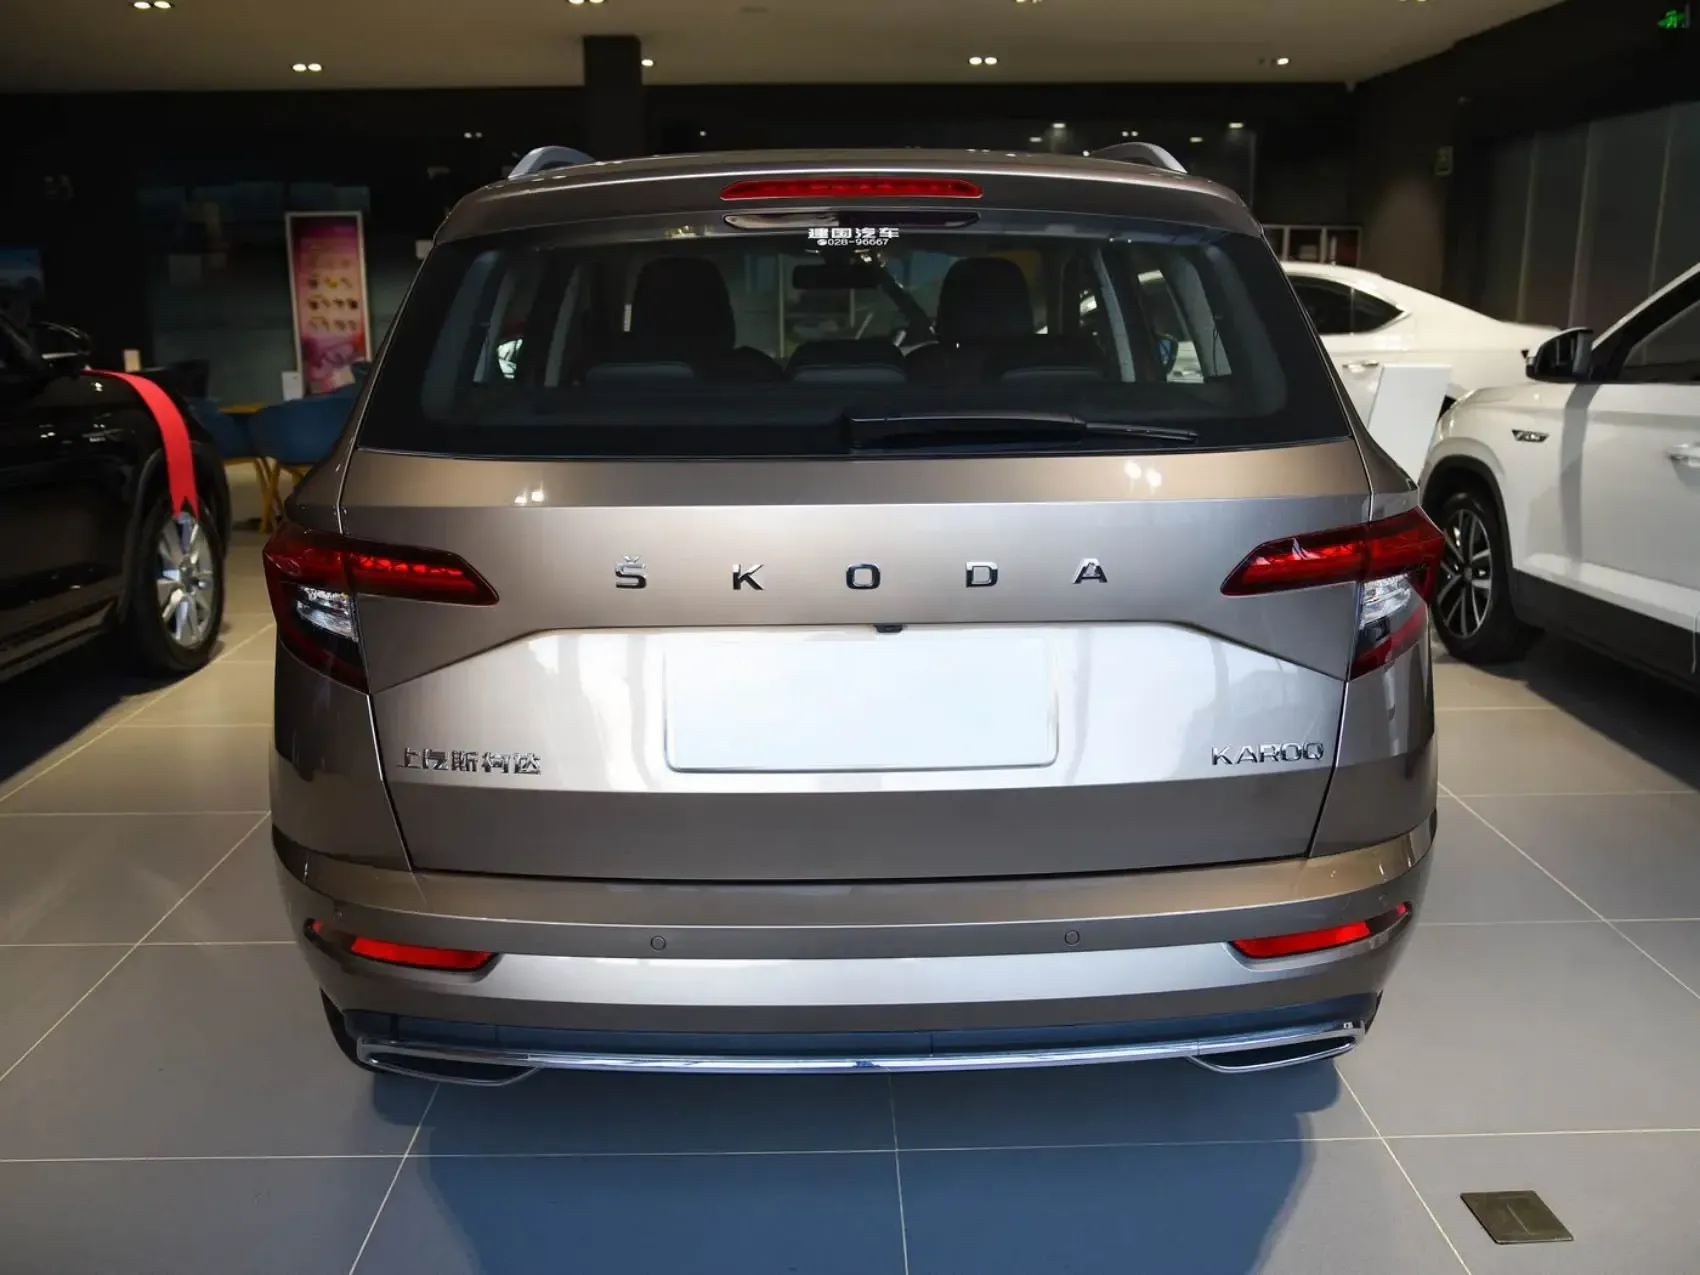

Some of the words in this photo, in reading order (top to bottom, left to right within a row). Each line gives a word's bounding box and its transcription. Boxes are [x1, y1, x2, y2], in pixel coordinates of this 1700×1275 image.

[615, 554, 1109, 591] ŠKODA
[397, 747, 542, 775] 上汽斯柯达
[1211, 741, 1325, 766] KAROQ
